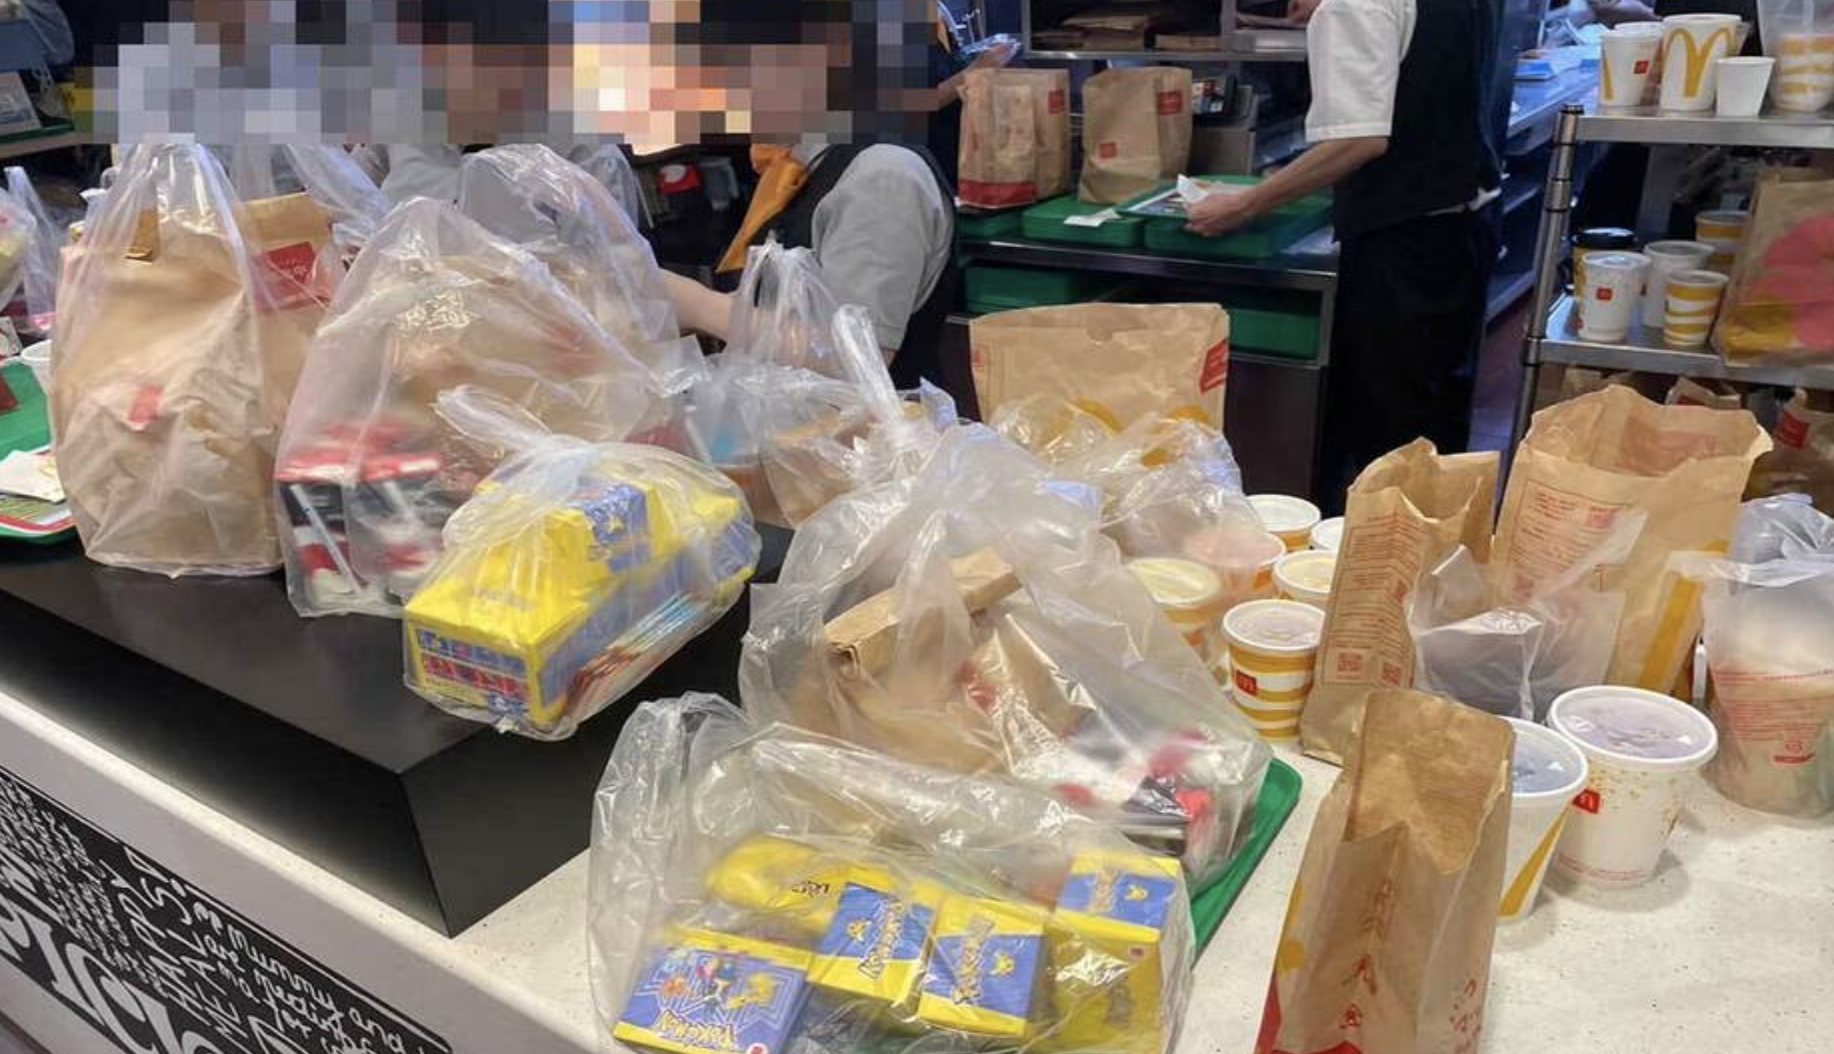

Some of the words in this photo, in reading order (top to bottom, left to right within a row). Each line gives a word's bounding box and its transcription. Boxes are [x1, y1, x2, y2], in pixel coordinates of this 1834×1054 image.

[99, 859, 212, 1026] HAPPY
[203, 934, 246, 973] are
[349, 1007, 407, 1054] and
